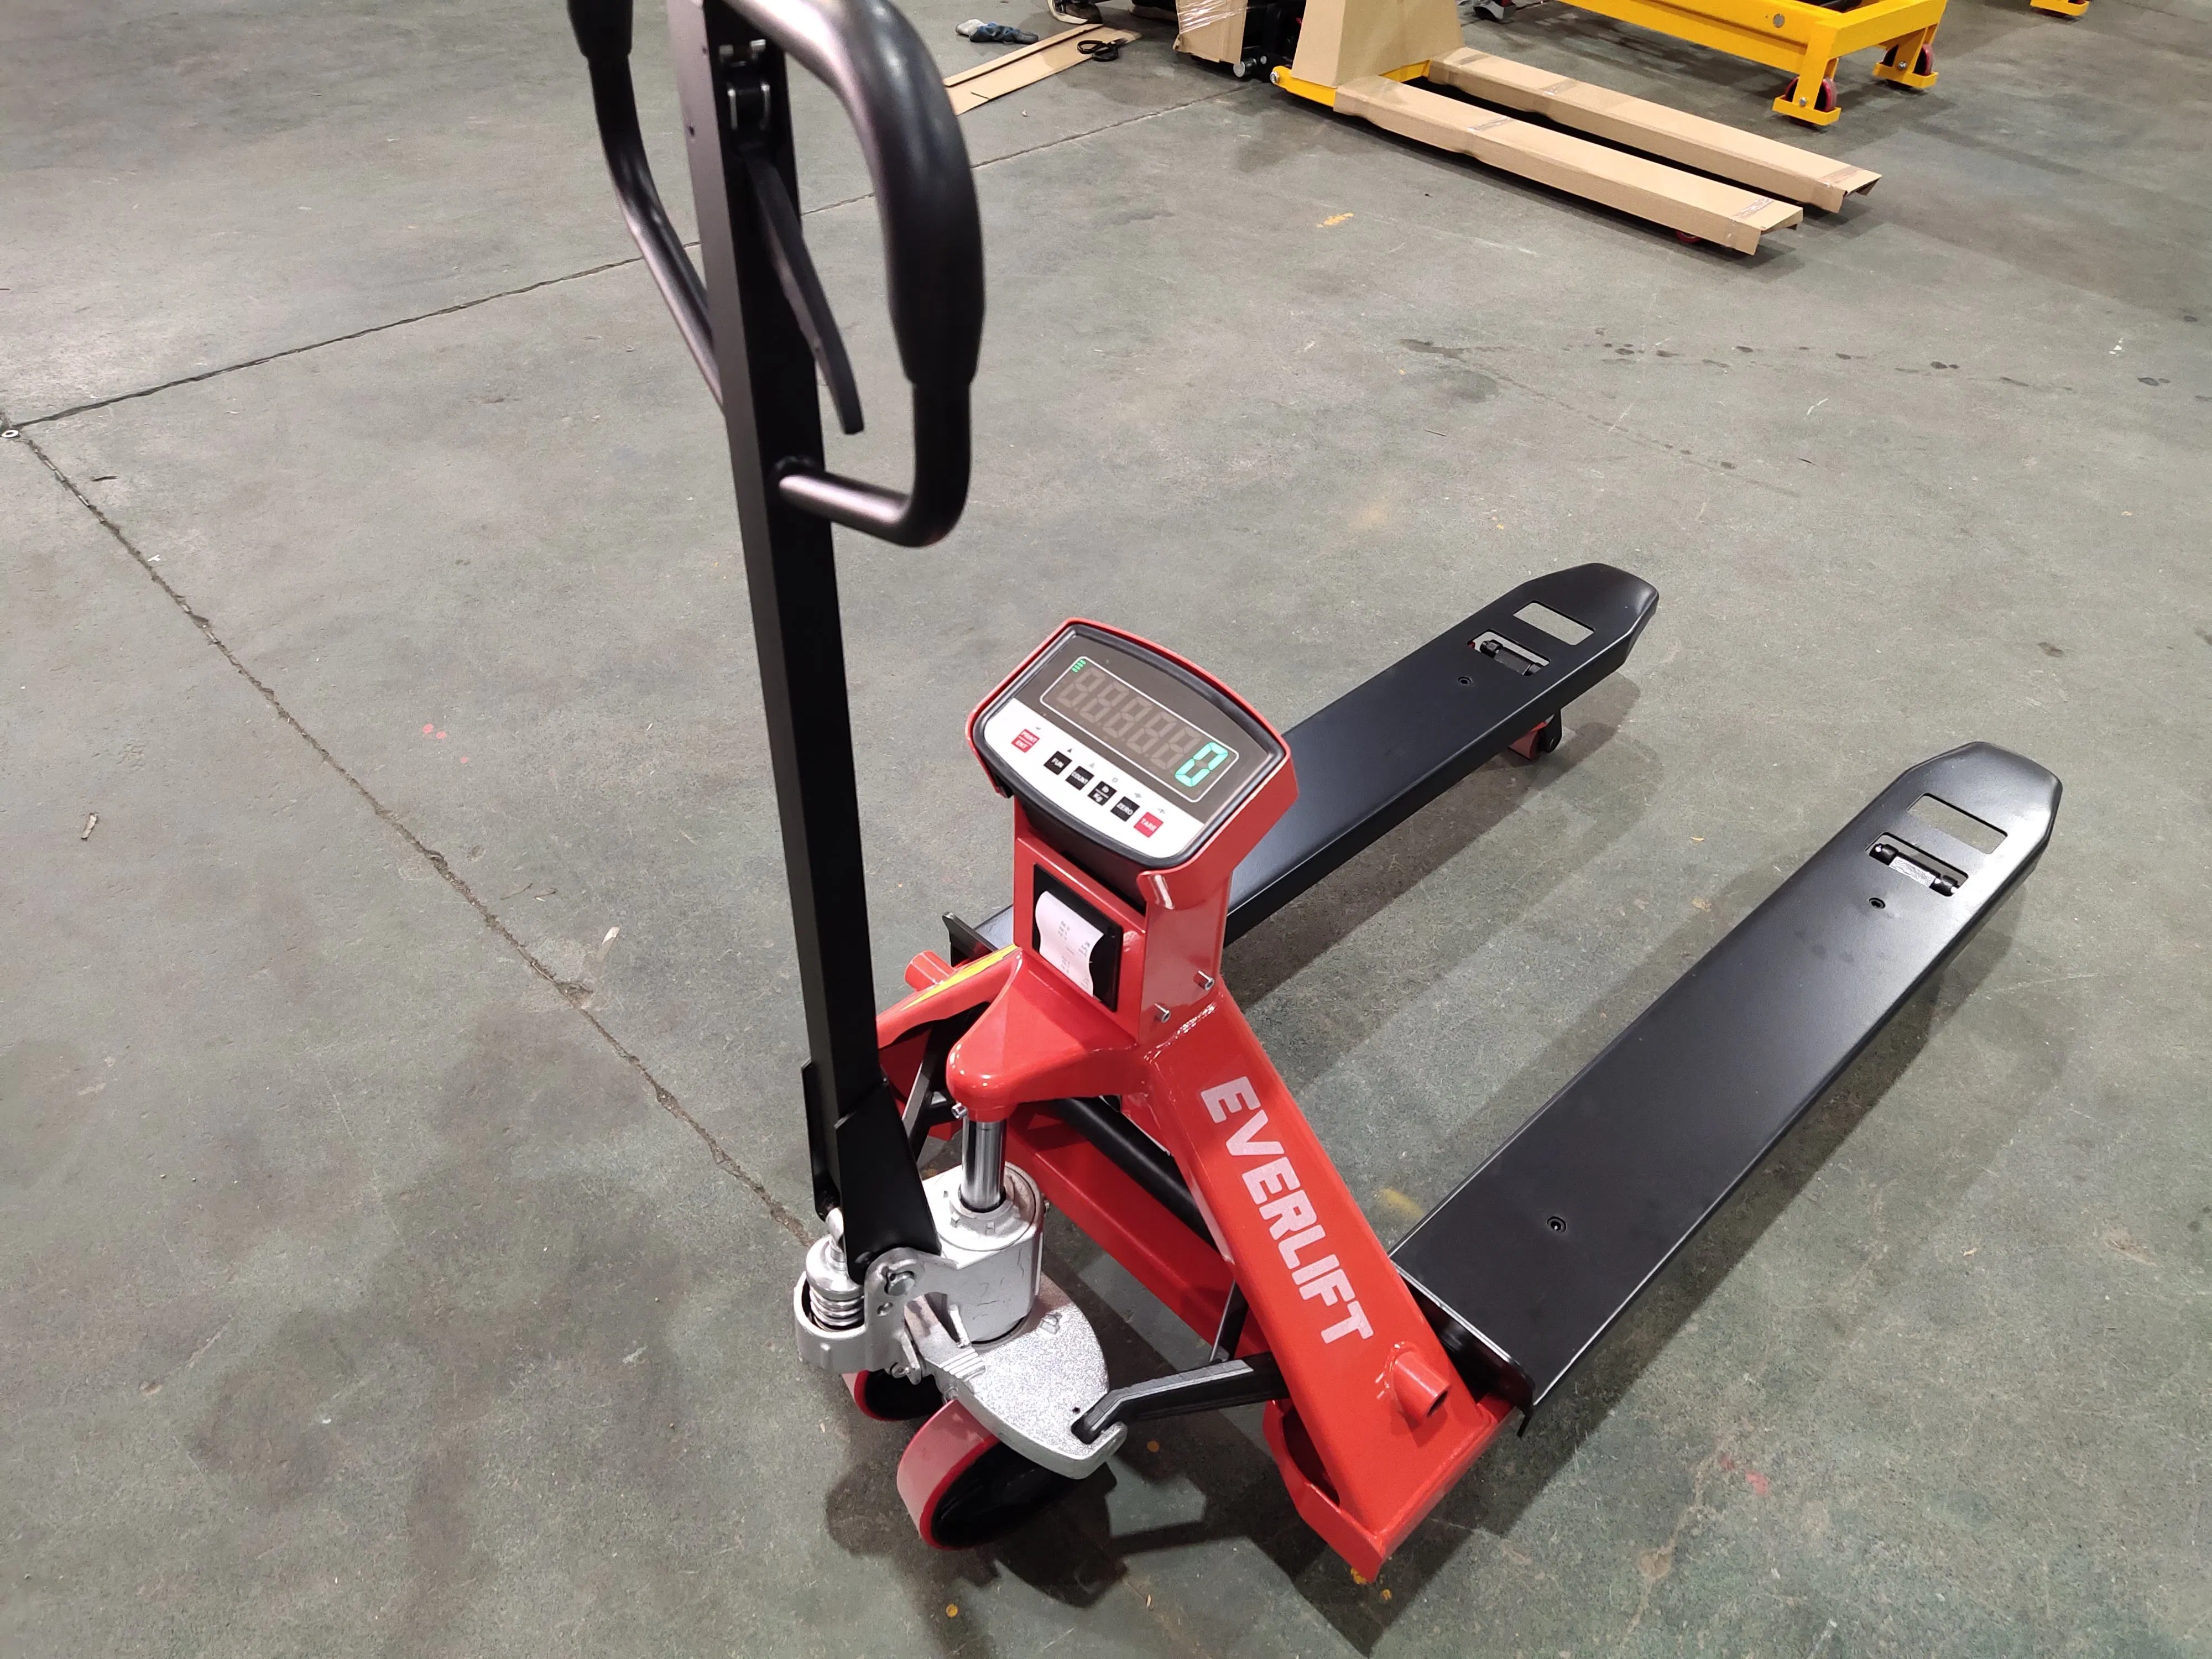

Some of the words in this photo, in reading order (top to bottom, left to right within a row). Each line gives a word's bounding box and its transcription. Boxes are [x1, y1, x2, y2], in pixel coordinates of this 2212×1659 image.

[1020, 730, 1039, 744] PRINT
[1051, 758, 1065, 769] FUN
[1175, 742, 1228, 787] 0
[1071, 771, 1089, 784] COUNT
[1116, 802, 1133, 815] ZERO
[1140, 818, 1157, 832] TARE
[1201, 1076, 1374, 1344] EVERLIFT
